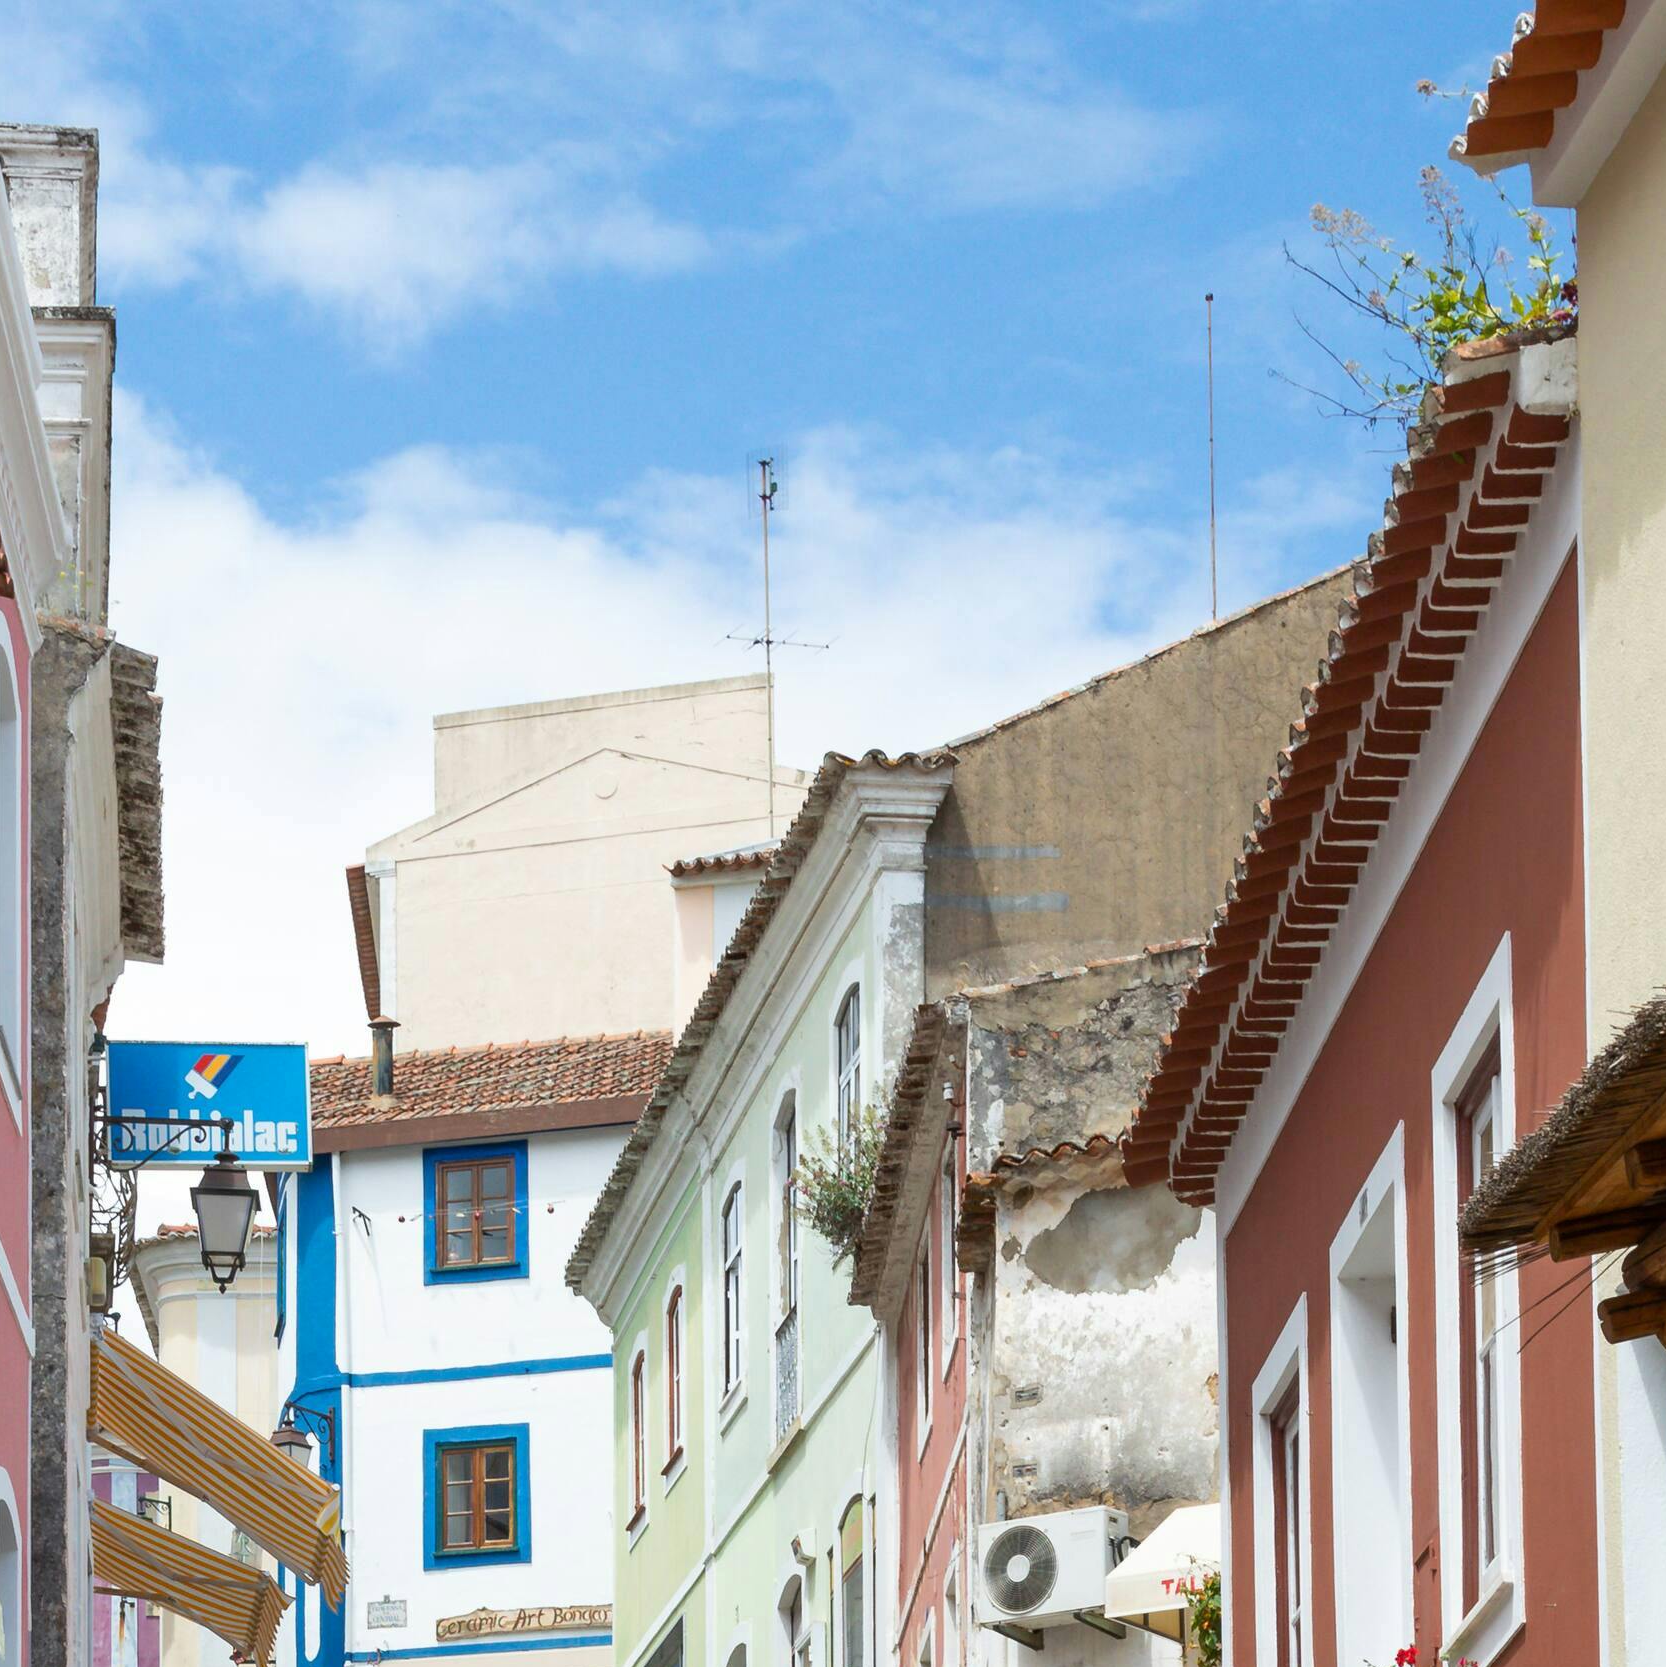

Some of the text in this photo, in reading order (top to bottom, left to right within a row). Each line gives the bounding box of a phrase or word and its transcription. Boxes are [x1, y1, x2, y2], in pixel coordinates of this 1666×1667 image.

[1160, 1574, 1200, 1596] TAL
[436, 1614, 509, 1639] Ceramic
[512, 1607, 547, 1632] Art
